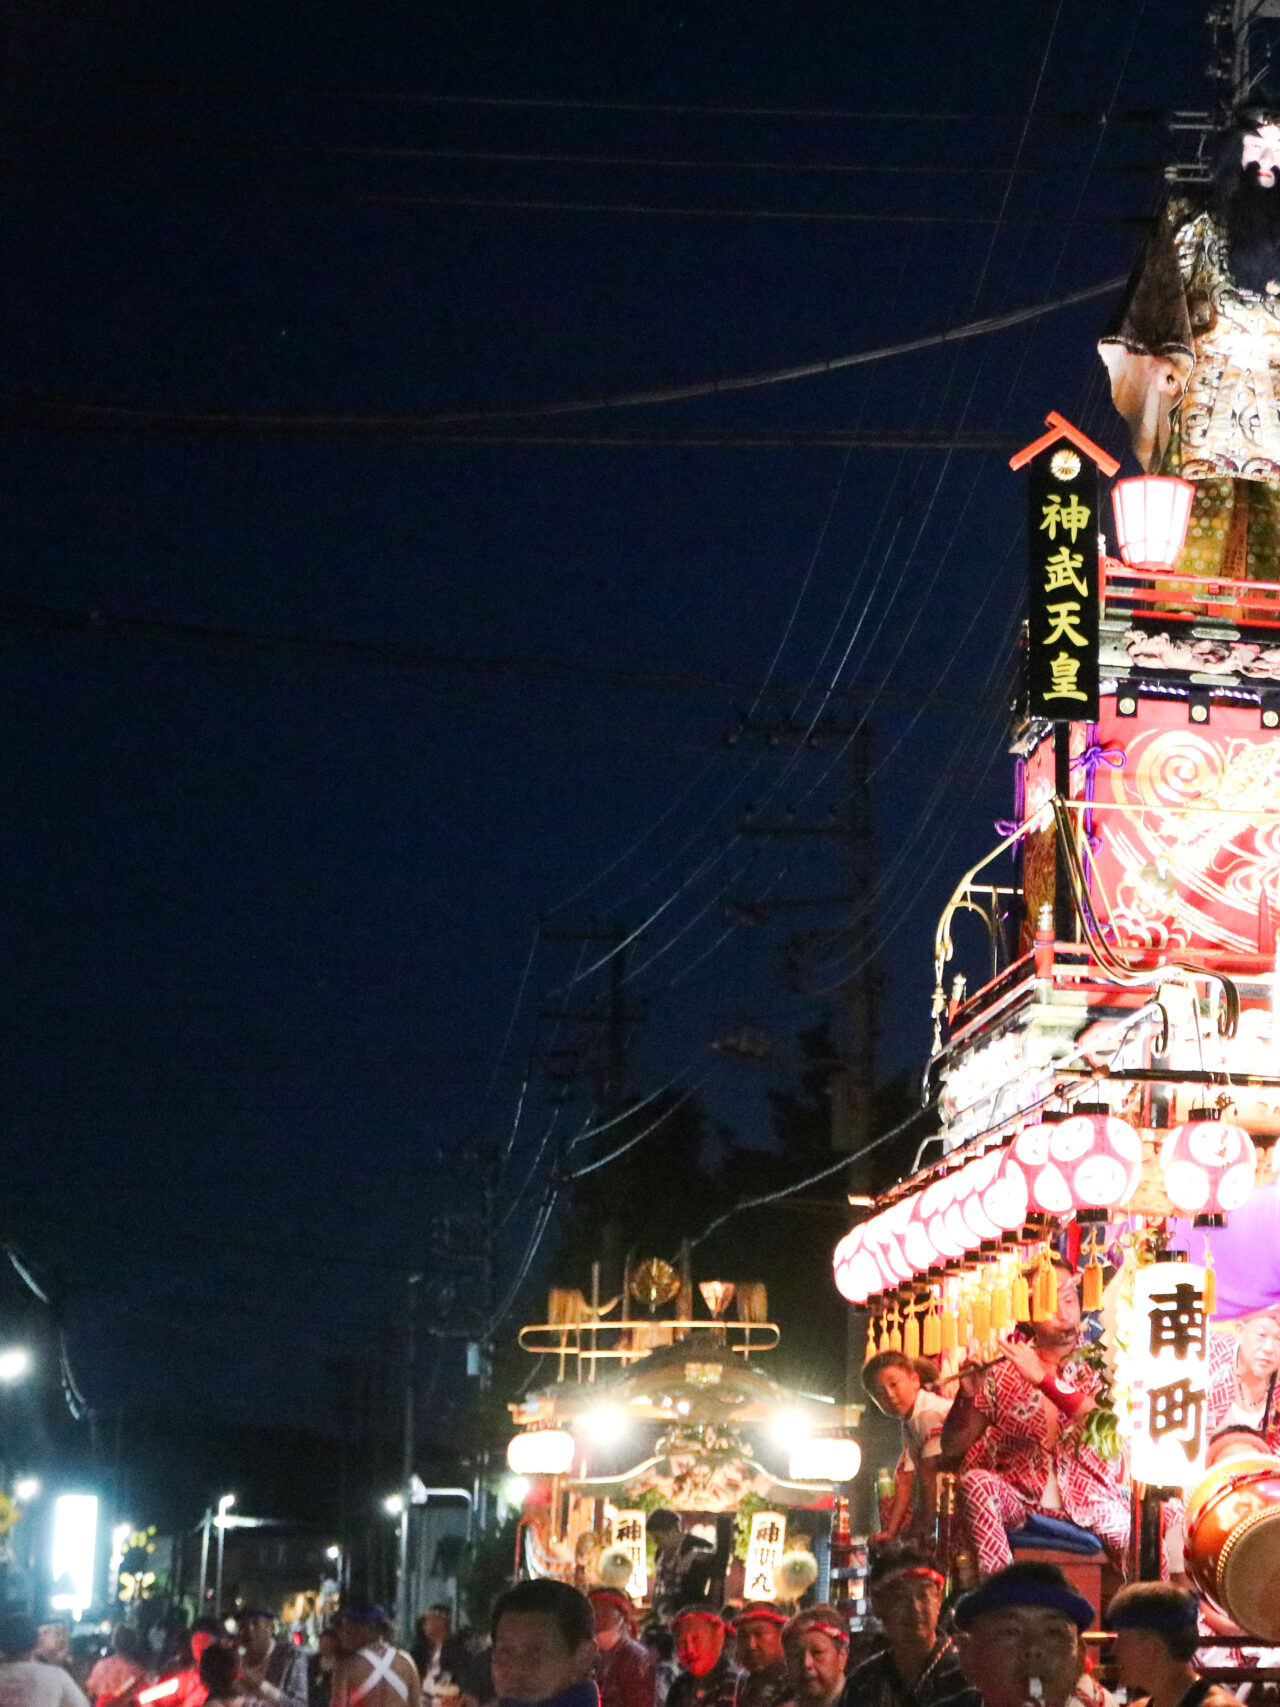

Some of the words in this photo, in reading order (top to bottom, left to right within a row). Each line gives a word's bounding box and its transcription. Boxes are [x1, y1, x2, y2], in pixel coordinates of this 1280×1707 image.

[1040, 495, 1092, 702] 神武天皇
[1148, 1283, 1208, 1463] 南町
